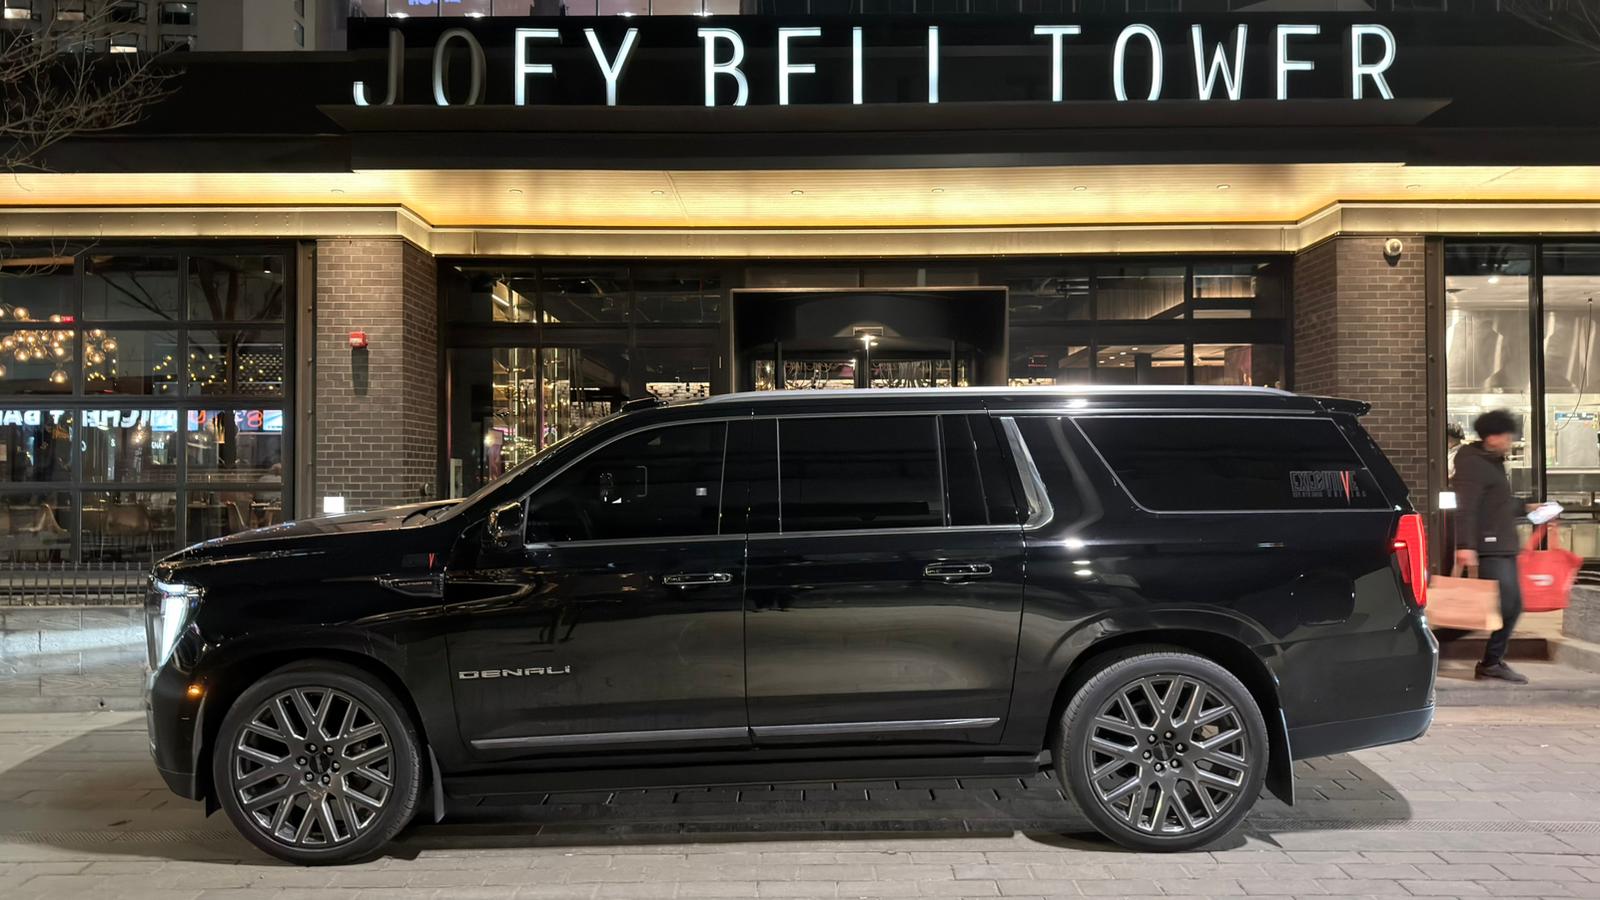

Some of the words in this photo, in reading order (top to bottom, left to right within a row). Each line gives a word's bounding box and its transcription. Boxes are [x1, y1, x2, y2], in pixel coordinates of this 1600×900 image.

[353, 28, 639, 106] JOEY
[1034, 24, 1396, 102] TOWER
[459, 665, 571, 679] DENALI
